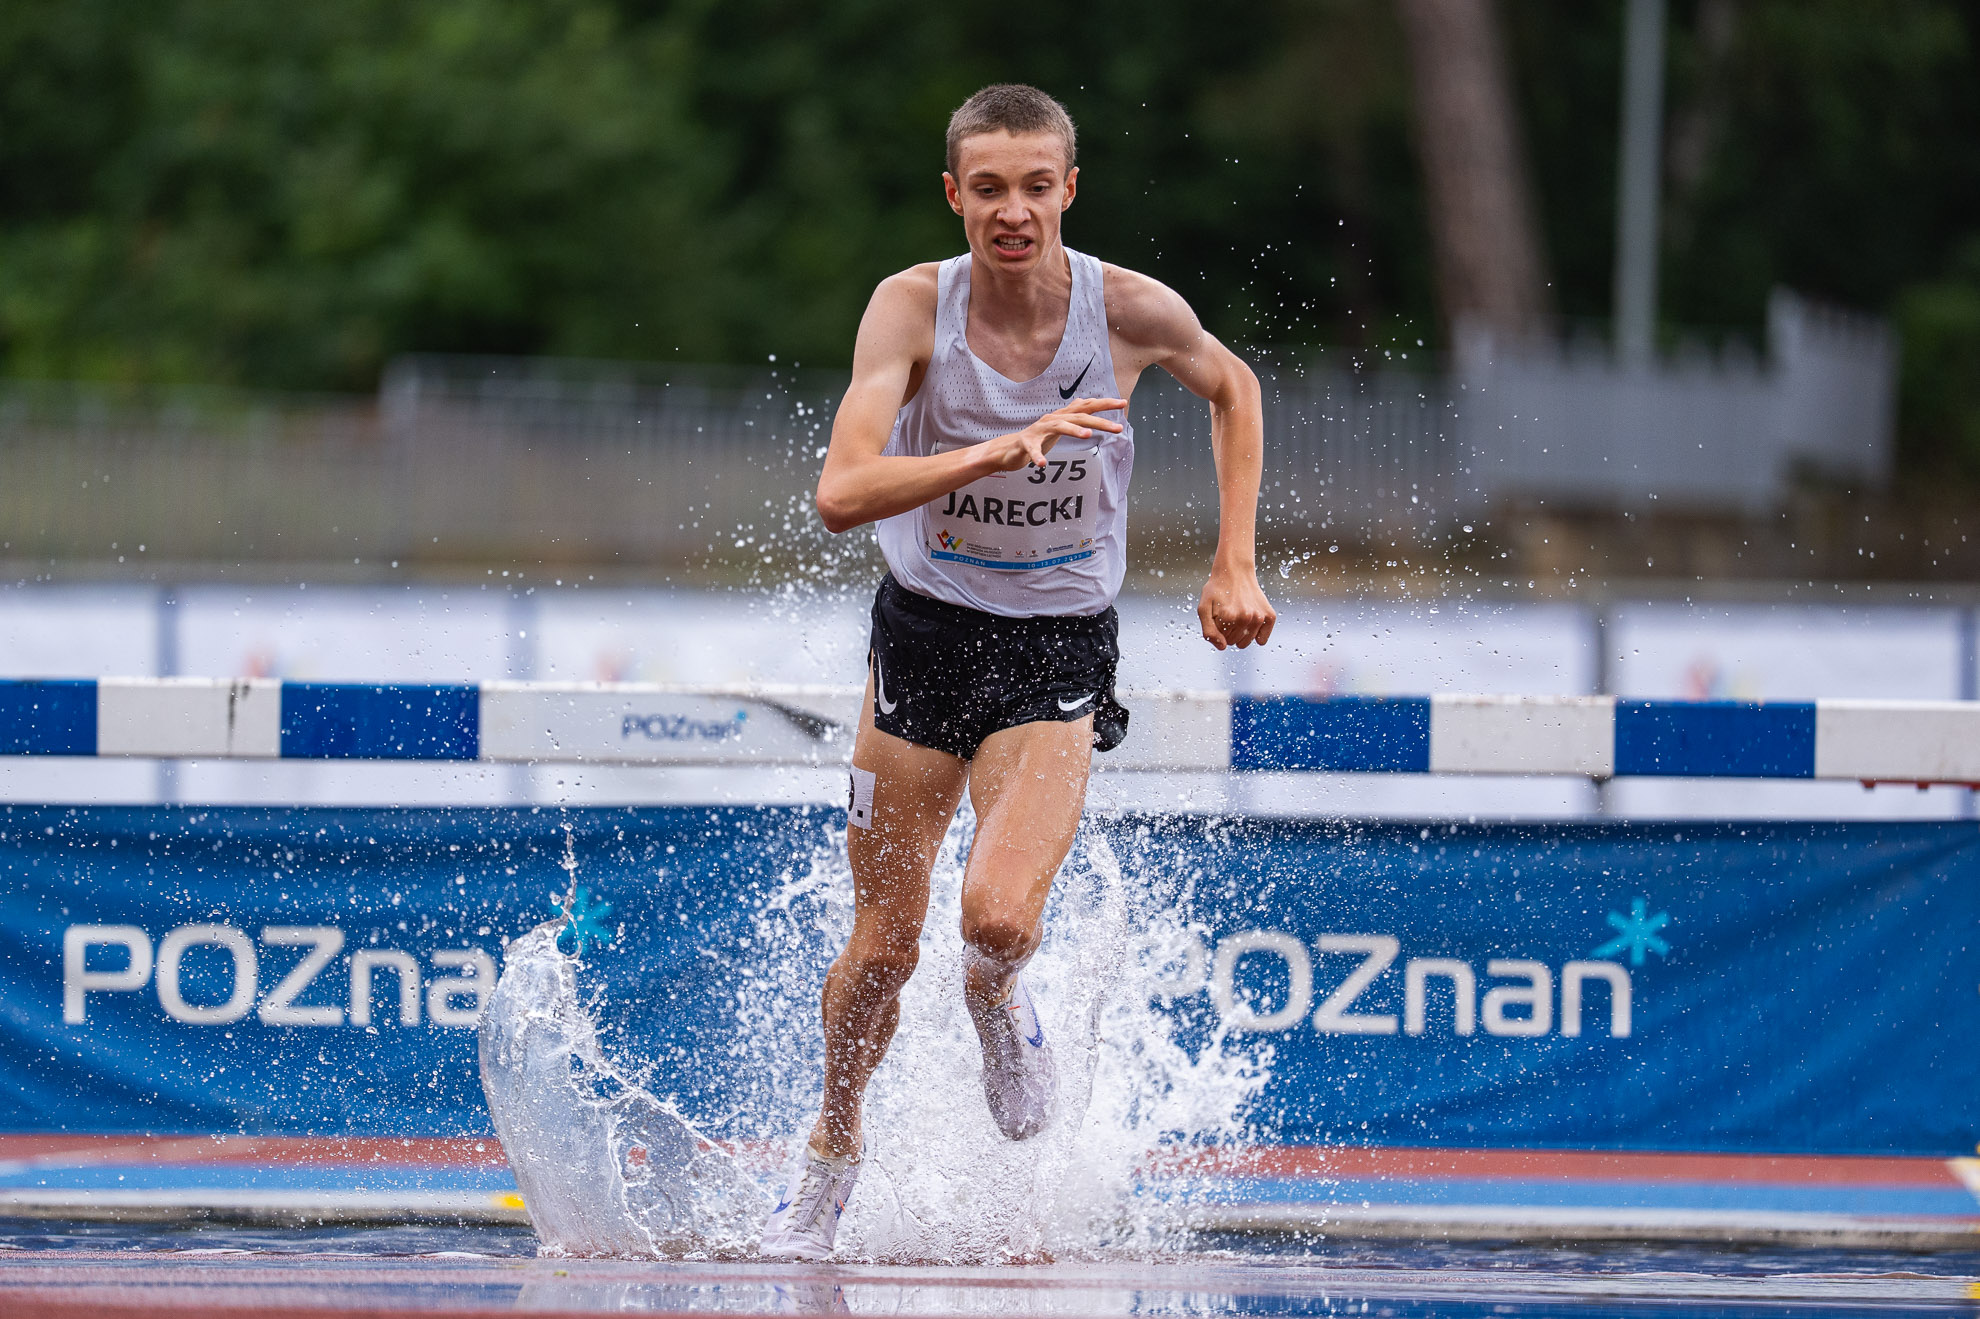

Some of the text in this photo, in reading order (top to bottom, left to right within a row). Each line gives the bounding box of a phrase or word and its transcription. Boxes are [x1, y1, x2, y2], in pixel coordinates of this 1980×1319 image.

[1026, 459, 1087, 485] 375
[942, 491, 1084, 528] JARECKI
[62, 923, 577, 1027] POZna
